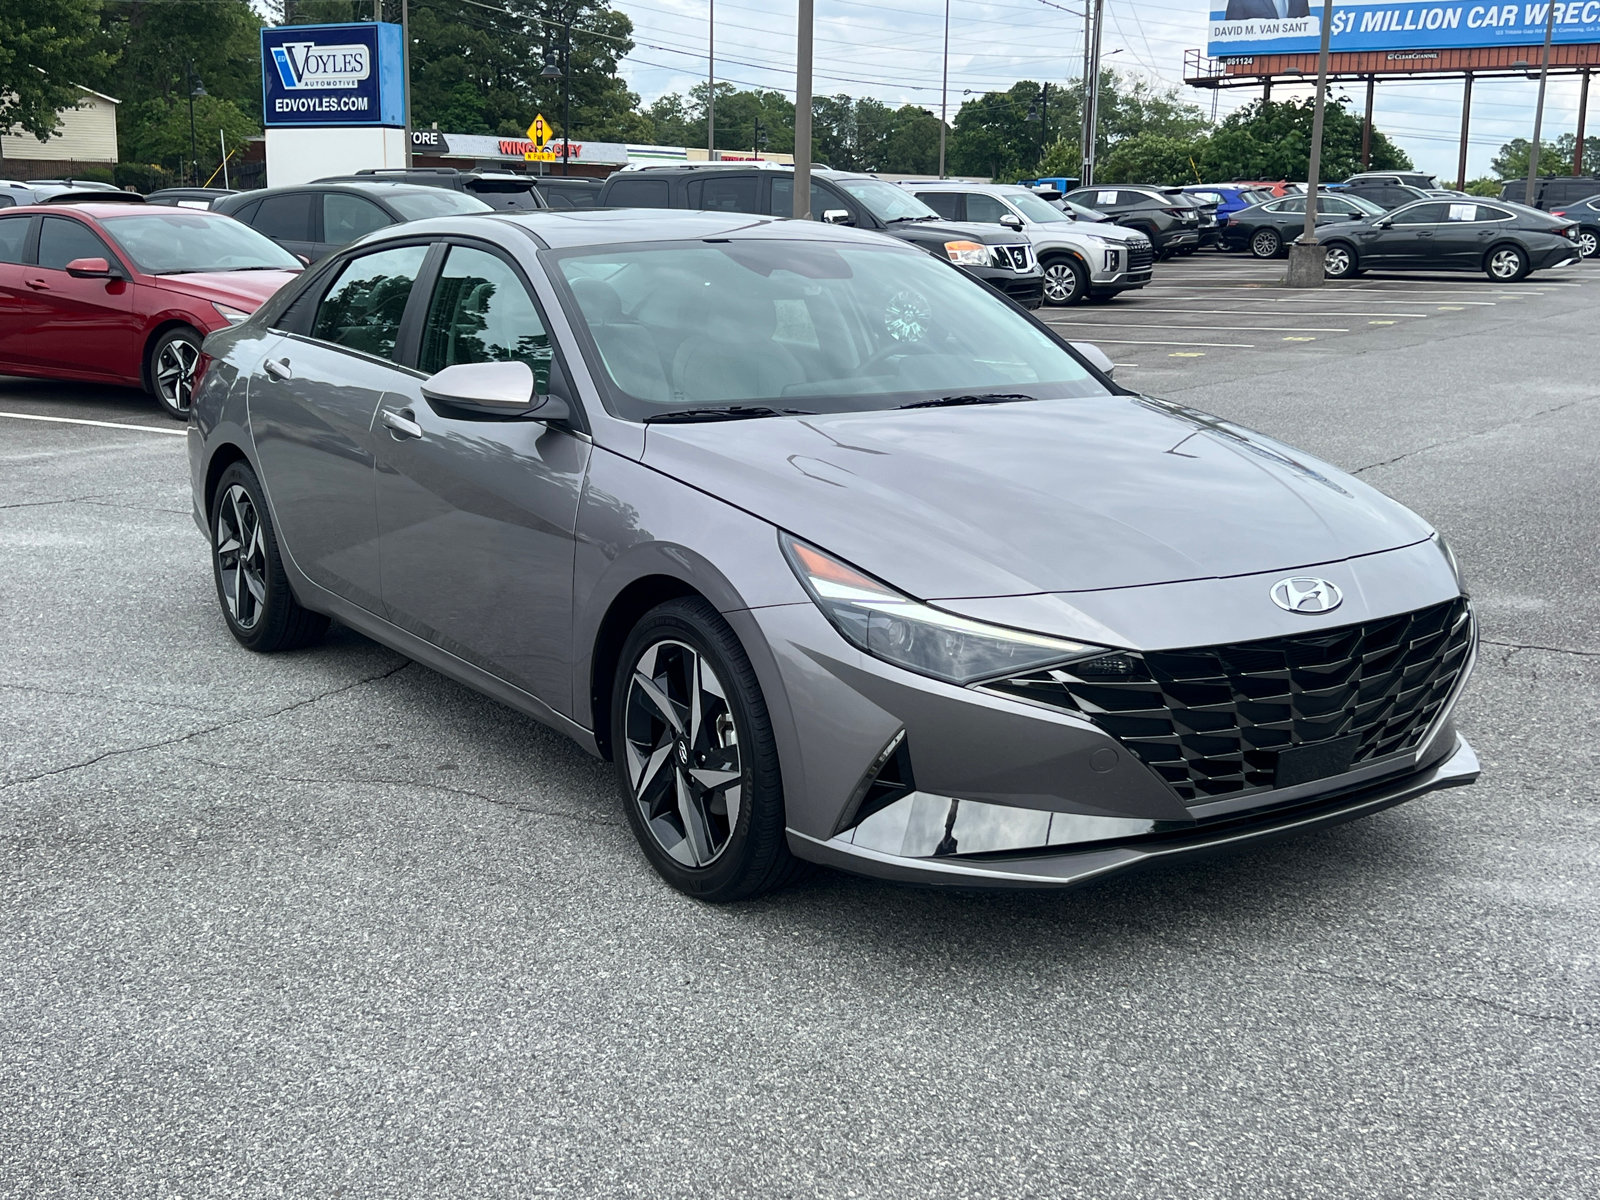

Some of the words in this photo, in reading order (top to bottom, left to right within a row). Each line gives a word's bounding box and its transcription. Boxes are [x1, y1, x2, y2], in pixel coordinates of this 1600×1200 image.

[1331, 10, 1356, 36] $1
[1360, 7, 1463, 32] MILLION
[1467, 5, 1519, 29] CAR
[1524, 1, 1600, 26] WREC
[1214, 26, 1243, 37] DAVID
[1245, 25, 1257, 35] M.
[1260, 23, 1280, 34] VAN
[1282, 22, 1309, 33] SANT
[285, 45, 364, 83] VOYLES
[1226, 57, 1253, 65] 061124
[304, 80, 356, 88] AUTOMOTIVE
[275, 97, 368, 113] EDVOYLES.COM
[741, 767, 753, 836] KUMHO
